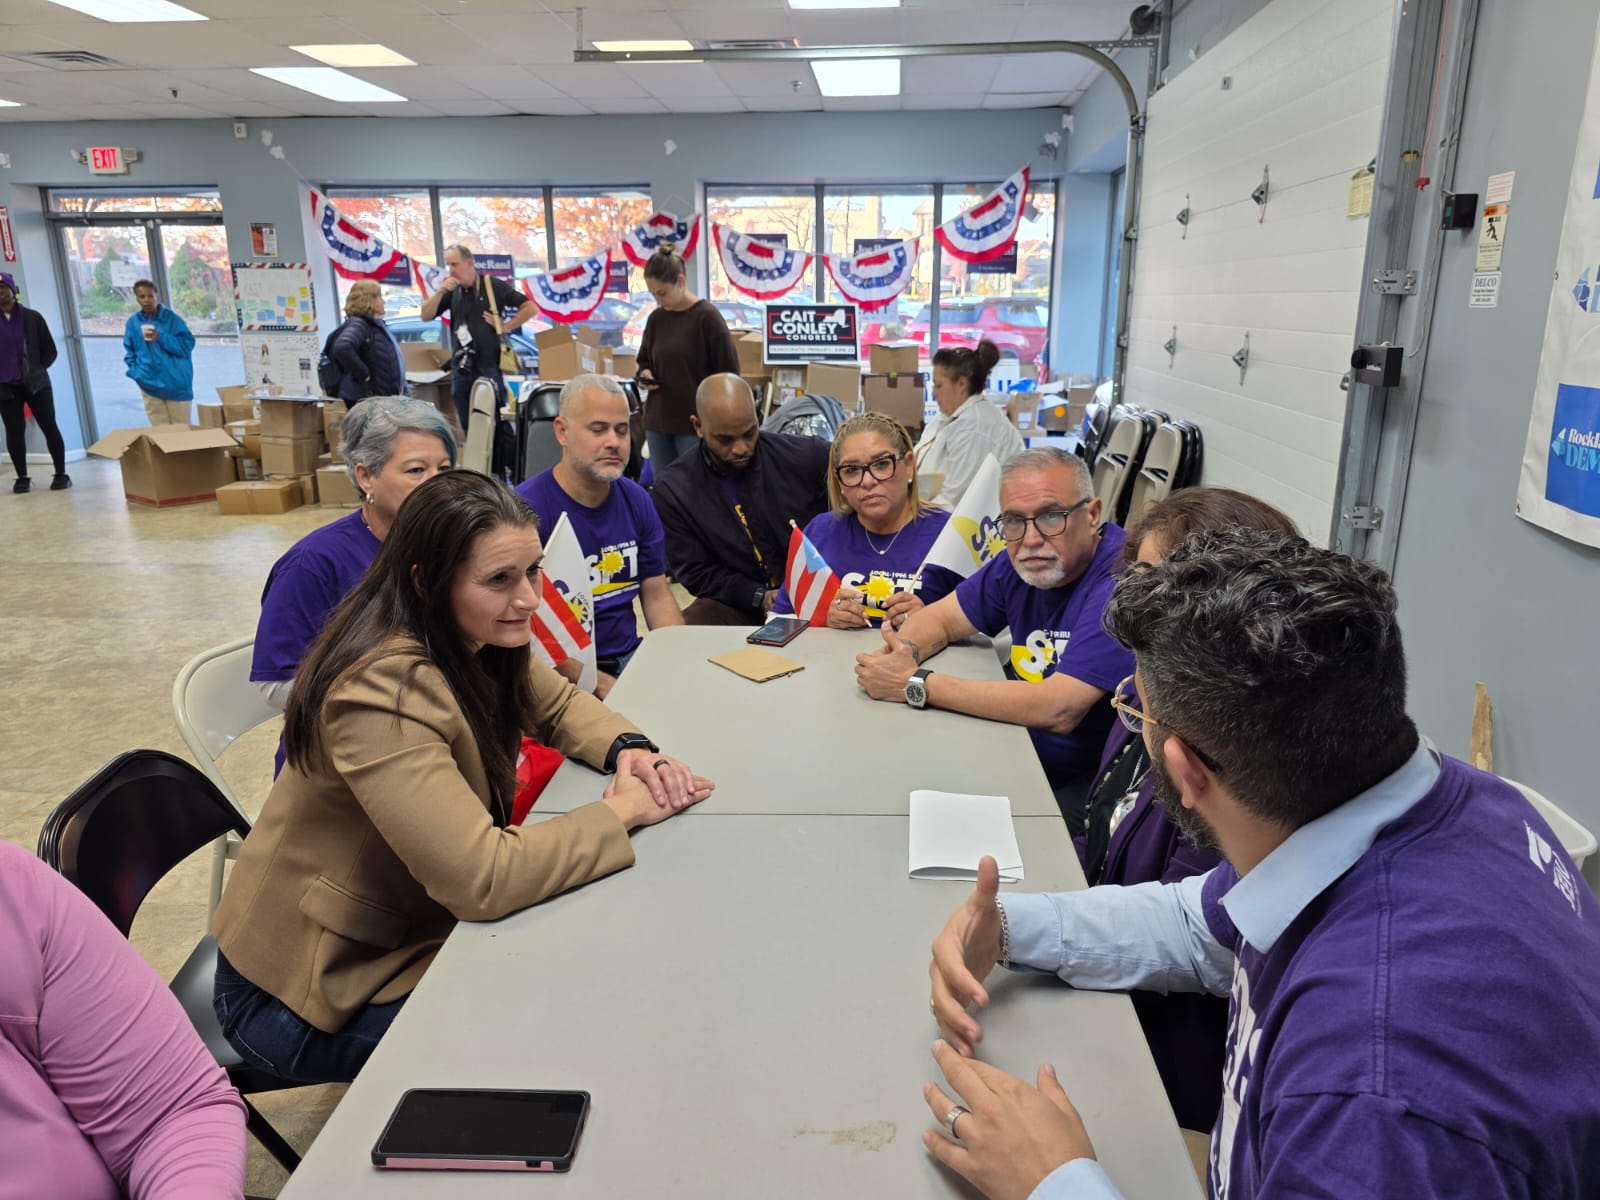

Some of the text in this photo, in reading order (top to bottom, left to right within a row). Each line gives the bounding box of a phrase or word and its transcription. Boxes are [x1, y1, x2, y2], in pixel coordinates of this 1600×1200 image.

[92, 147, 117, 169] EXIT
[1474, 278, 1497, 288] DELCO
[780, 310, 816, 322] CAIT
[772, 322, 837, 335] CONLEY
